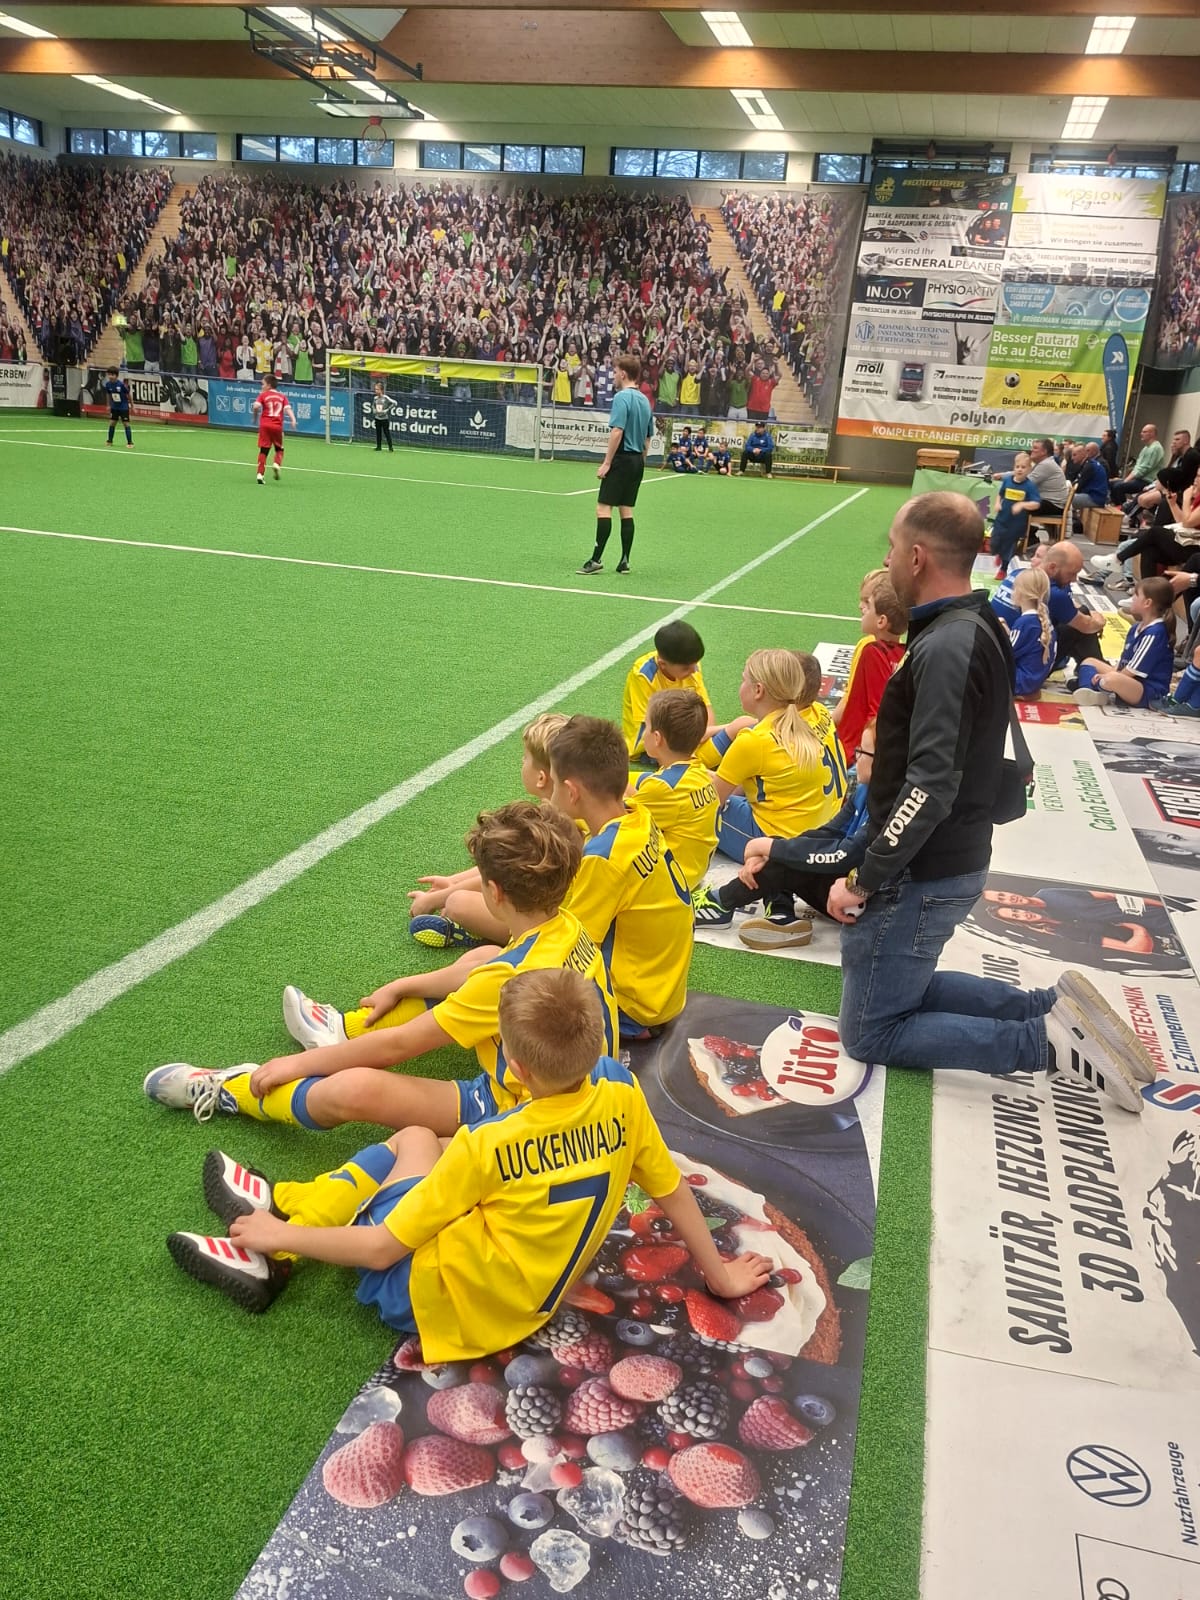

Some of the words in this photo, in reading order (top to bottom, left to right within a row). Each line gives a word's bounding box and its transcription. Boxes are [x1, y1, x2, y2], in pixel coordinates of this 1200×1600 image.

[884, 247, 899, 255] Wir
[921, 247, 935, 255] Ihr
[895, 257, 1002, 272] GENERALPLANER
[866, 285, 913, 299] INJOY
[927, 283, 997, 297] PHYSIOAKTIV
[923, 311, 967, 319] PHYSIOTHERAPIE
[878, 330, 939, 339] INSTANDSETZUNG
[879, 323, 950, 334] KOMMUNALTECHNIK
[992, 331, 1034, 343] Besser
[1036, 334, 1078, 346] autark
[991, 345, 1008, 355] als
[1011, 348, 1026, 356] au
[1030, 346, 1071, 358] Backe!
[130, 381, 161, 402] FIGHT
[267, 401, 282, 417] 12
[1002, 398, 1021, 406] Beim
[1022, 399, 1057, 409] Hausbau,
[1059, 401, 1069, 409] Ihr
[405, 405, 437, 419] jetzt
[950, 410, 1006, 426] polytan
[409, 421, 448, 436] durch
[540, 421, 585, 432] Neumarkt
[872, 425, 979, 444] KOMPLETT-ANBIETER
[982, 433, 1004, 444] FÜR
[1084, 805, 1117, 832] Carlo
[777, 1026, 841, 1095] Jütro
[991, 1093, 1051, 1202] HEIZUNG,
[1051, 1076, 1133, 1250] BADPLANUNG
[537, 1171, 611, 1313] 7
[989, 1210, 1073, 1354] SANITÄR,
[1078, 1252, 1144, 1303] 3D
[1168, 1441, 1199, 1546] Nutzfahrzeuge
